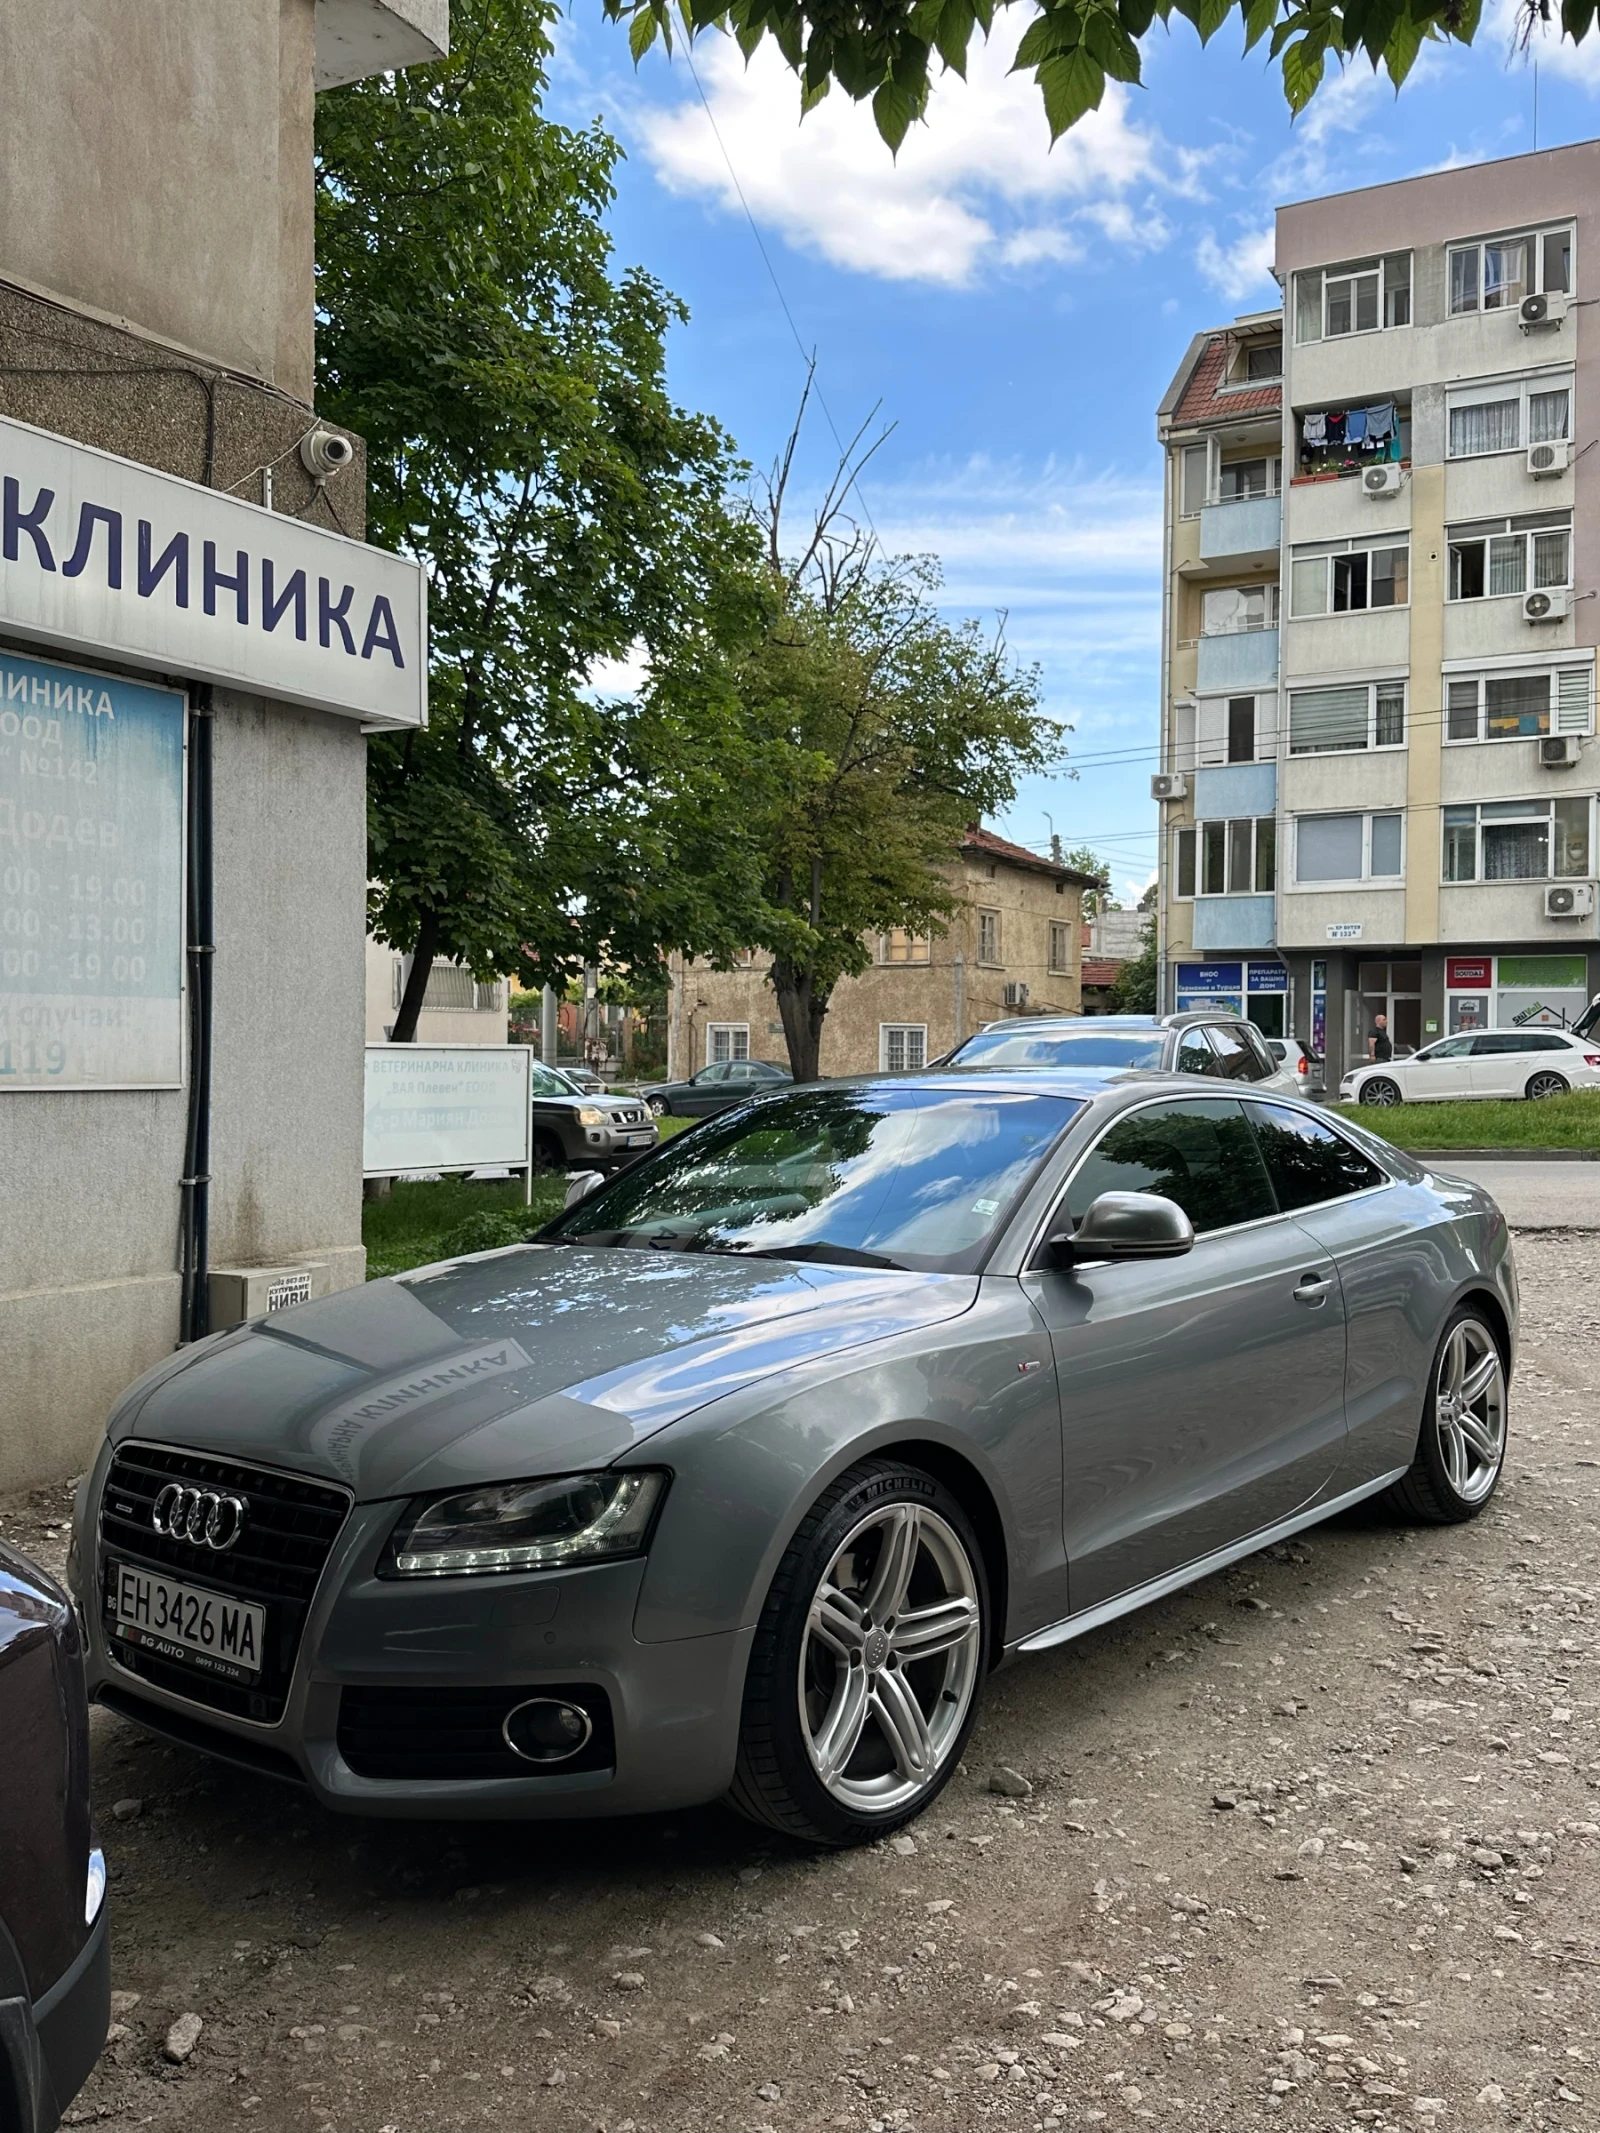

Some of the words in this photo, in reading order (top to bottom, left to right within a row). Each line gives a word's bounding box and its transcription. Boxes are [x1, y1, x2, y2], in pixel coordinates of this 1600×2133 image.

[3, 475, 405, 669] КЛИНИКА
[372, 1060, 454, 1074] ВЕТЕРИНАРНА
[456, 1060, 509, 1073] КЛИНИКА
[269, 1290, 309, 1312] НИВИ
[866, 1477, 934, 1499] MICHELIN
[107, 1594, 117, 1610] BG
[140, 1634, 155, 1648] BG
[155, 1641, 185, 1659] AUTO
